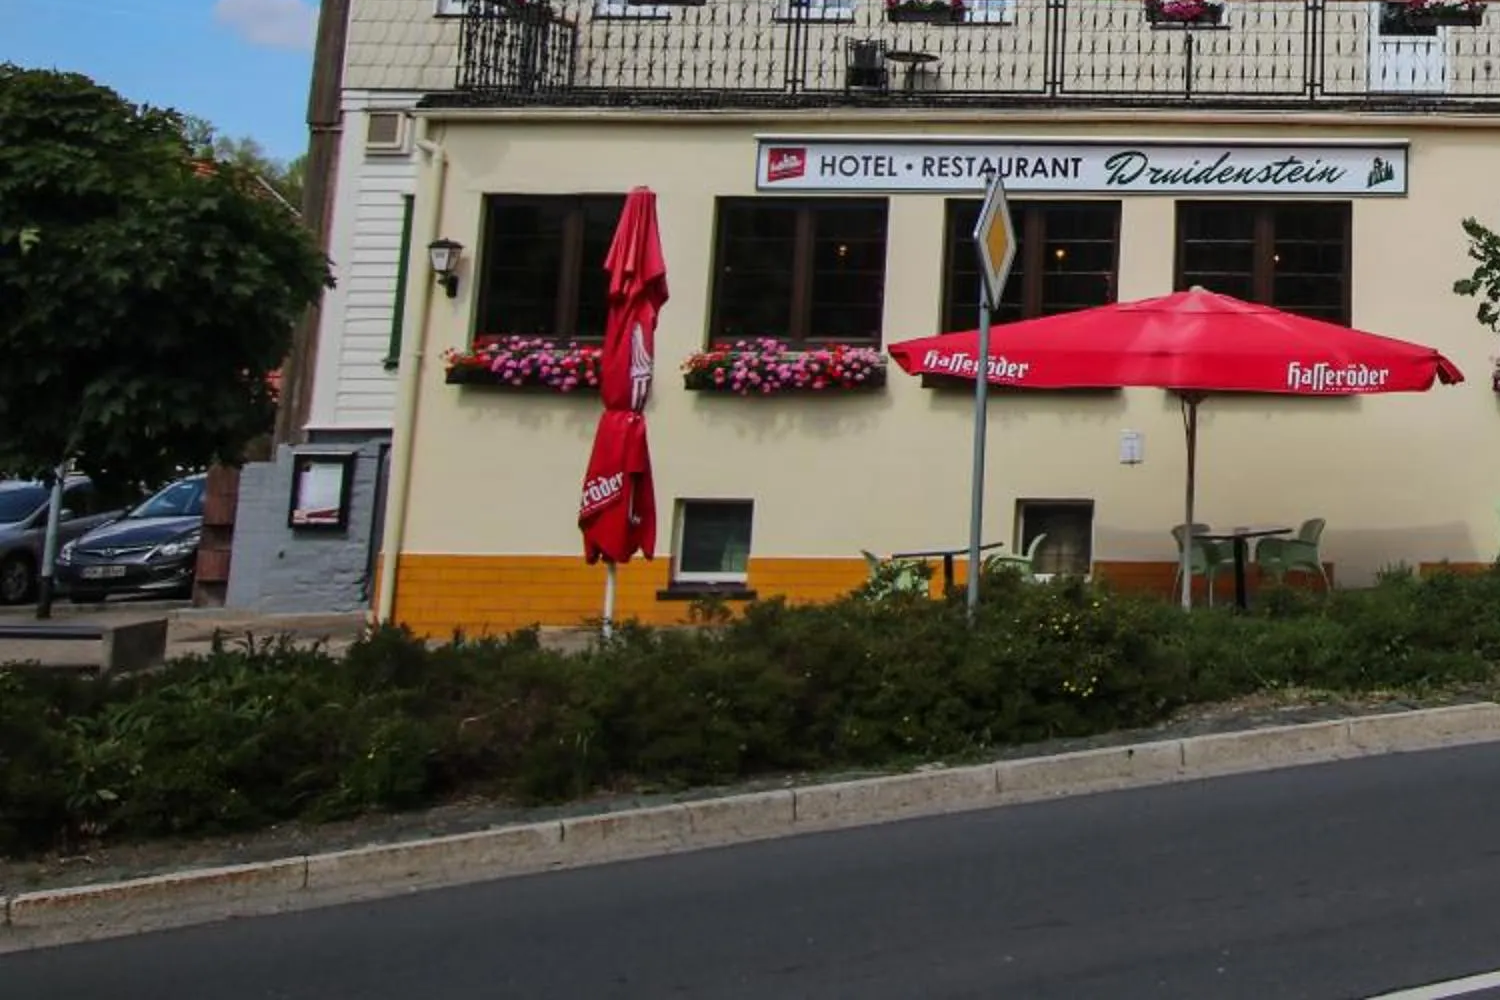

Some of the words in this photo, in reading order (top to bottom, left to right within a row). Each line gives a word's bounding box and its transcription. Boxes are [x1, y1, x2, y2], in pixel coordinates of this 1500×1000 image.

[819, 155, 898, 177] HOTEL
[921, 156, 1083, 178] RESTAURANT
[1104, 150, 1347, 186] Druidenstein
